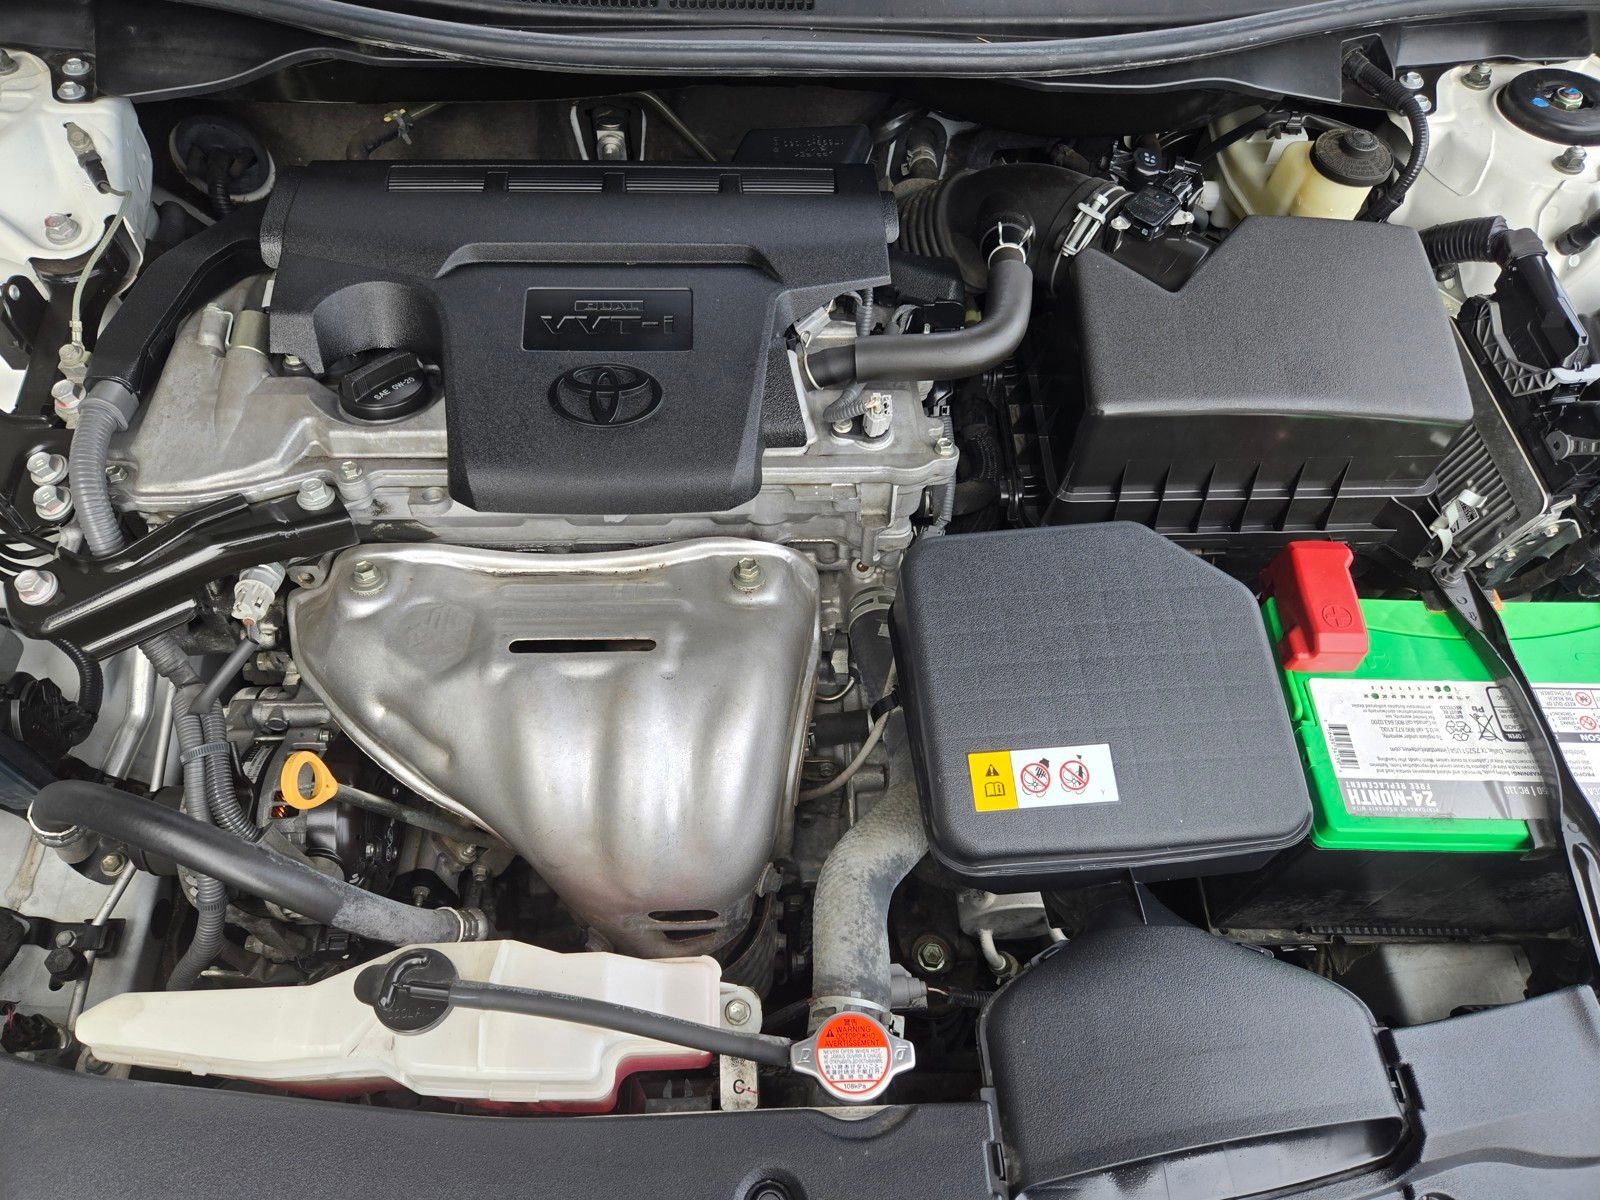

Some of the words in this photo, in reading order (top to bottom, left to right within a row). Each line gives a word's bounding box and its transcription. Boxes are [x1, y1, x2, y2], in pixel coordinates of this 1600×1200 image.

[540, 315, 674, 335] VVT-i
[373, 388, 391, 400] SAE
[391, 376, 416, 391] 0W-20
[1345, 781, 1407, 790] REPLACEMENT
[1409, 782, 1432, 790] FREE
[1503, 785, 1518, 794] 110
[1519, 786, 1530, 795] RC
[1346, 789, 1437, 807] 24-MONTH
